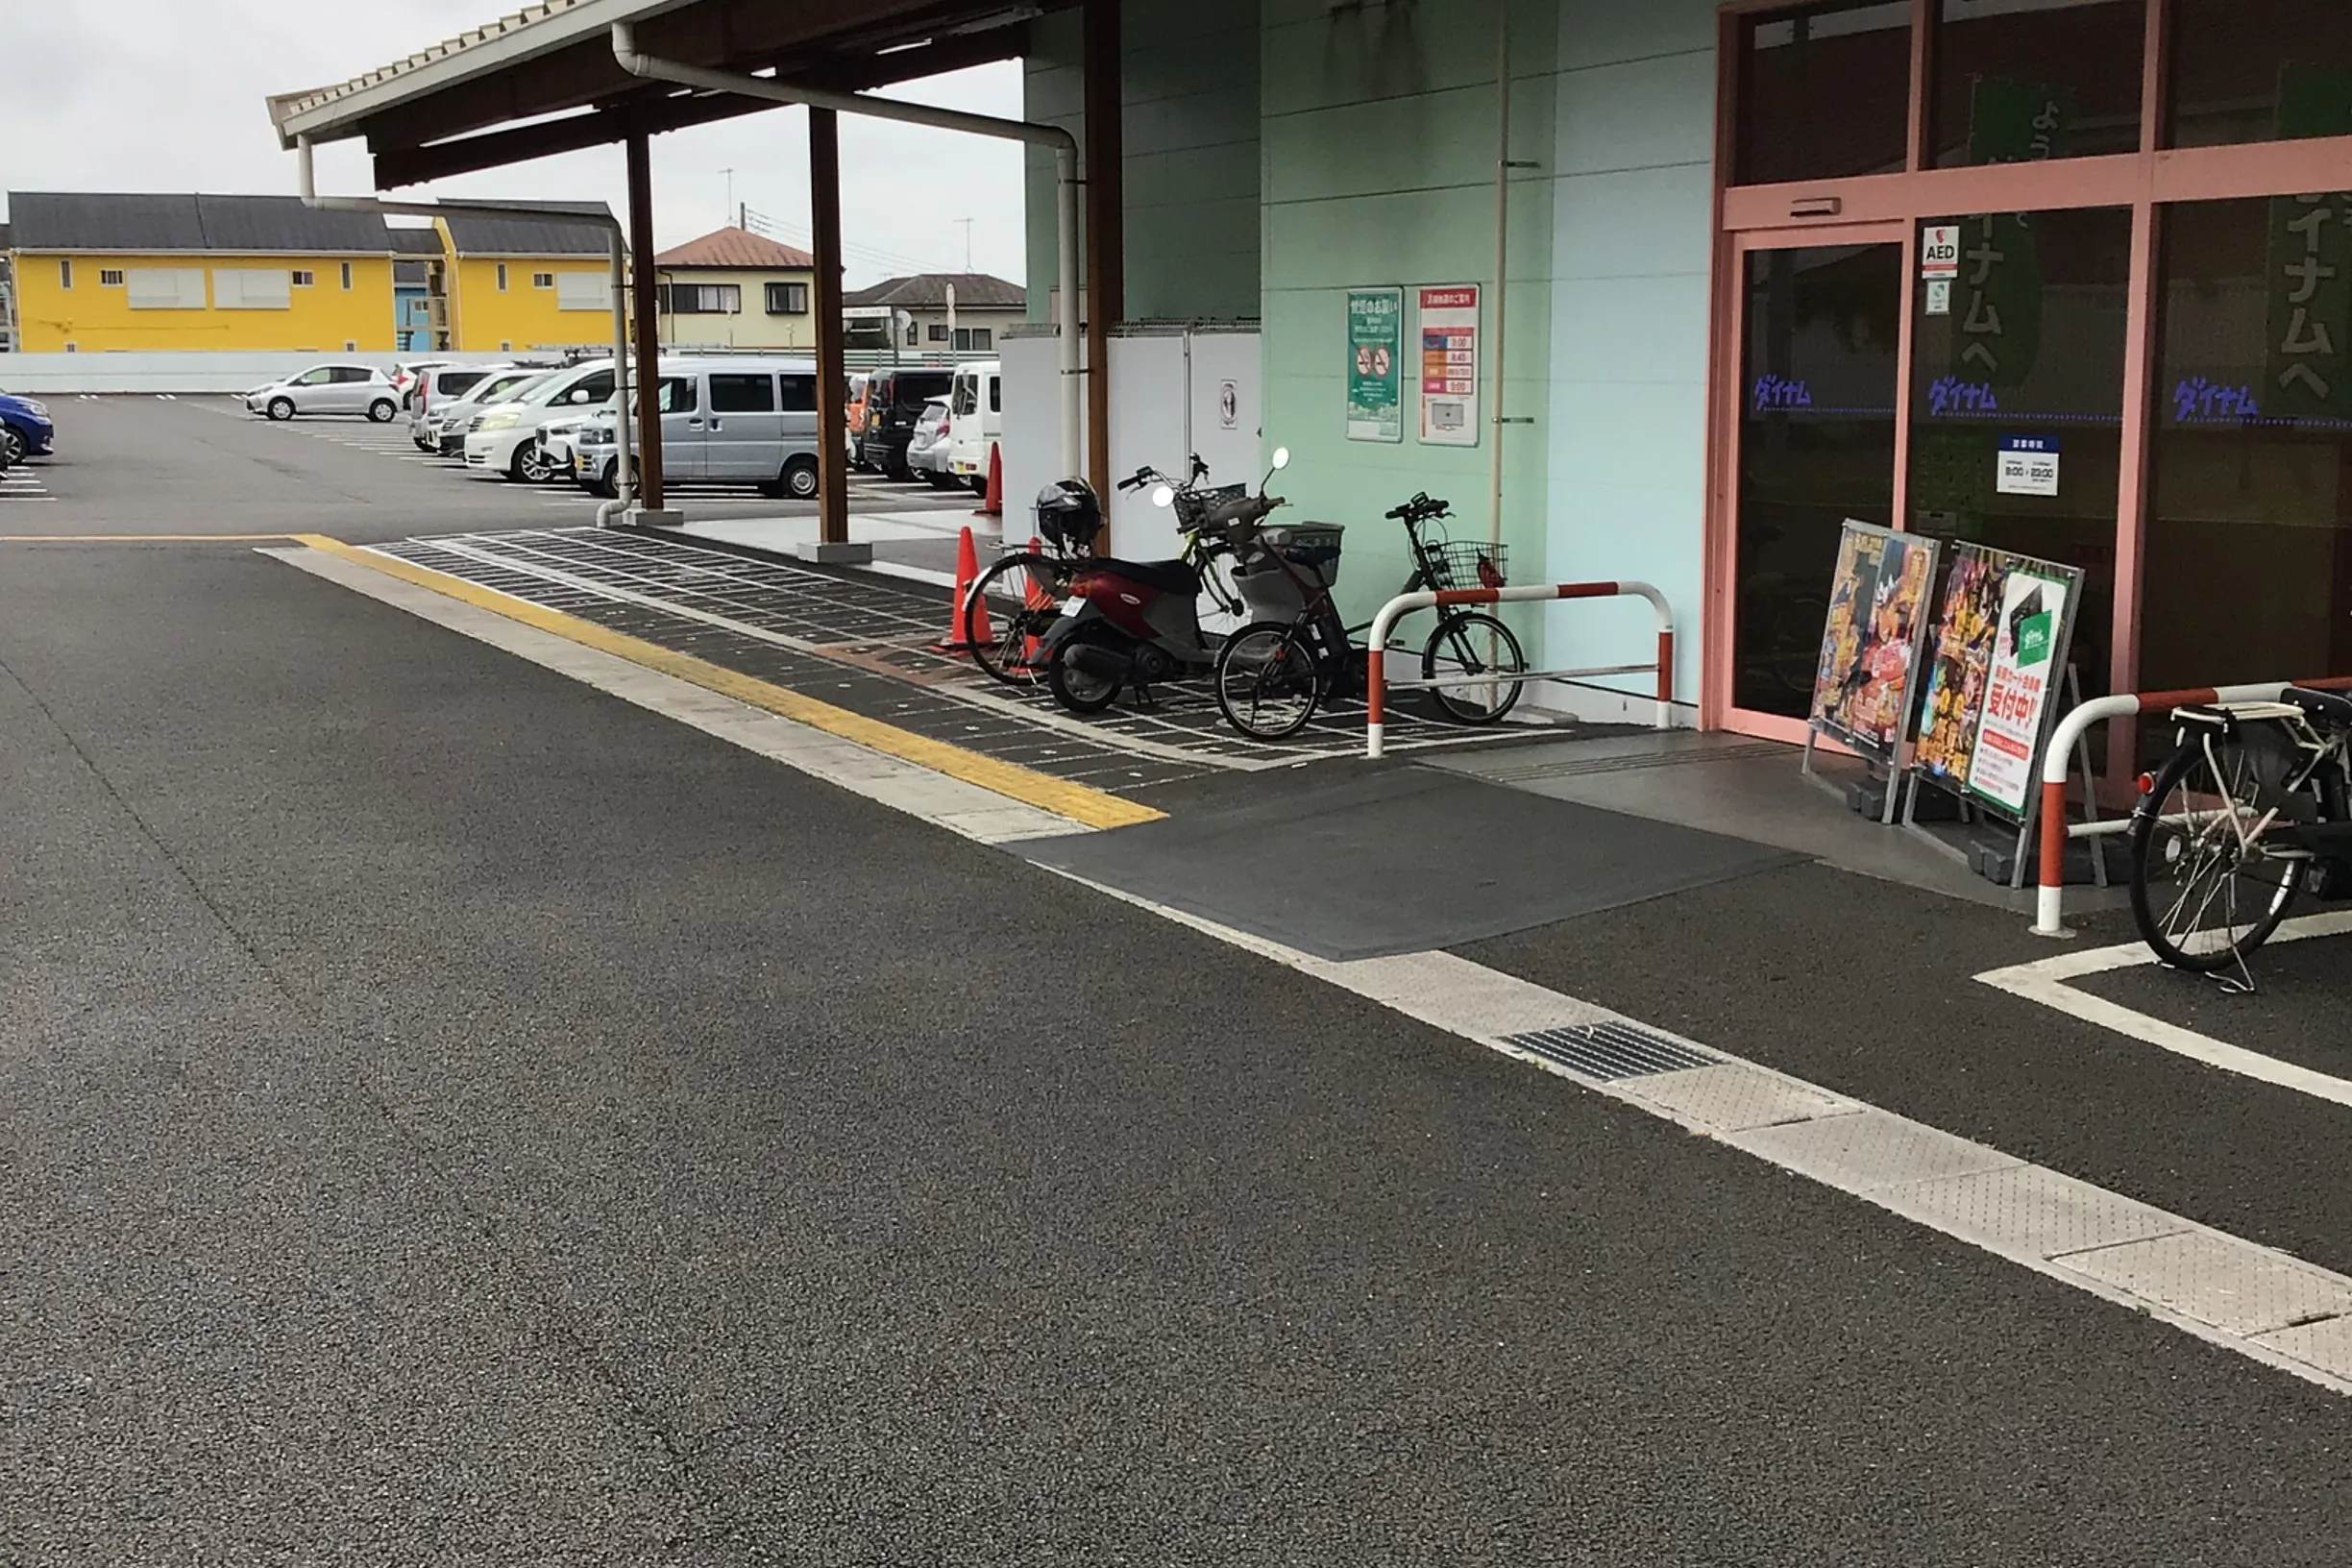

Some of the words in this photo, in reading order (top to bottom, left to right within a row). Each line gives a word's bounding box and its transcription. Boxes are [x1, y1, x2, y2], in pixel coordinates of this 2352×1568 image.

[1925, 244, 1955, 260] AED
[2278, 194, 2336, 400] イナムへ
[1753, 373, 1812, 412] ダイナム
[1927, 374, 1997, 413] ダイナム
[2172, 376, 2259, 421] ダイナム
